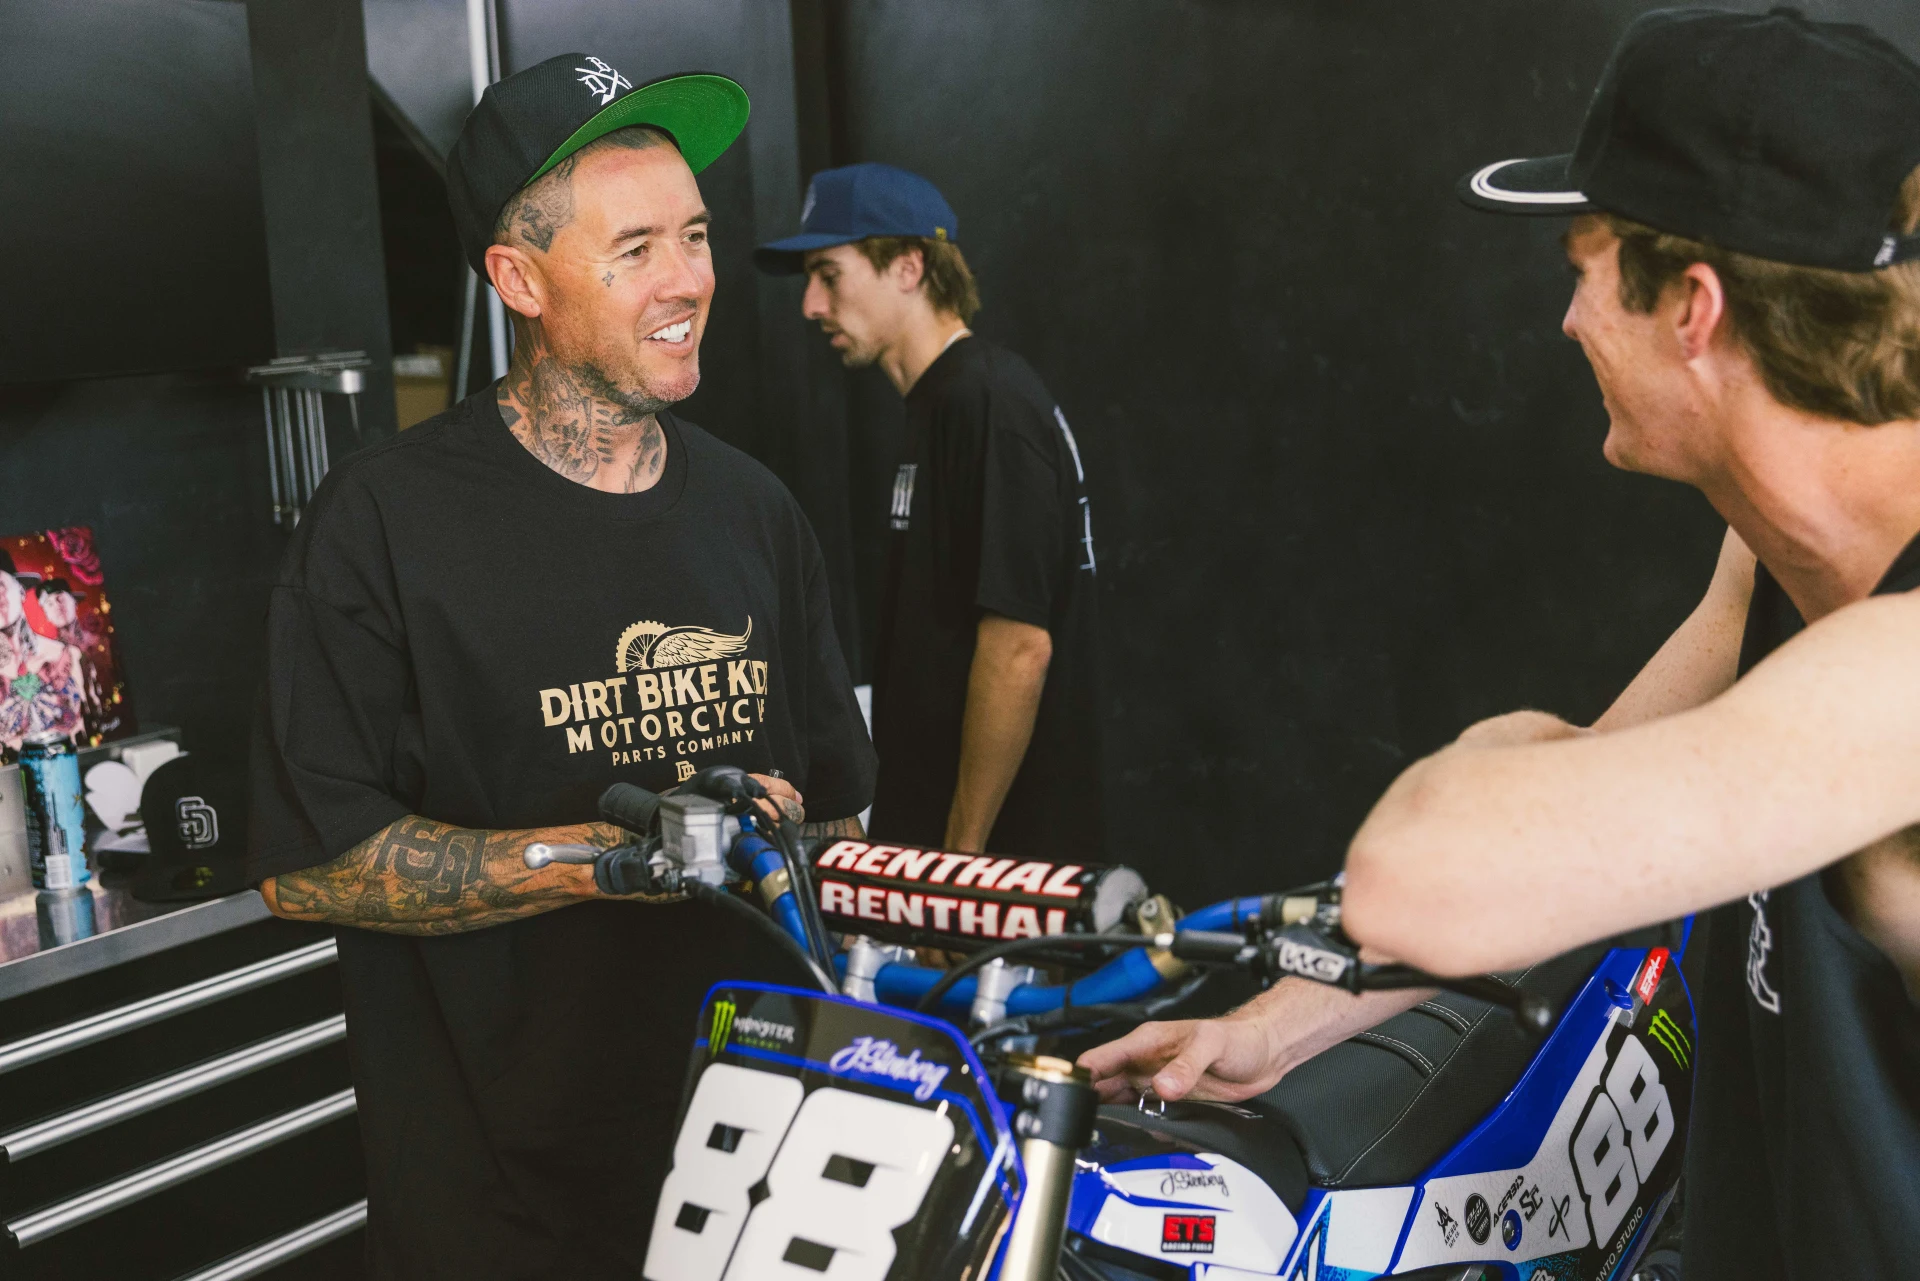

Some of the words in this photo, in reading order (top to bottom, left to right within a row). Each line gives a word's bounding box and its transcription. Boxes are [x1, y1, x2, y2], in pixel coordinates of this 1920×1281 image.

[539, 676, 628, 728] DIRT
[636, 663, 721, 711] BIKE
[612, 745, 667, 766] PARTS
[676, 729, 755, 755] COMPANY
[817, 840, 1084, 898] RENTHAL
[733, 1015, 795, 1044] MONSTER
[1573, 1034, 1675, 1250] 88
[642, 1062, 955, 1281] 88
[1493, 1175, 1524, 1228] ACERBIS
[1164, 1215, 1215, 1242] ETS
[1444, 1220, 1459, 1246] ANCHOR
[1616, 1206, 1643, 1253] STUDIO
